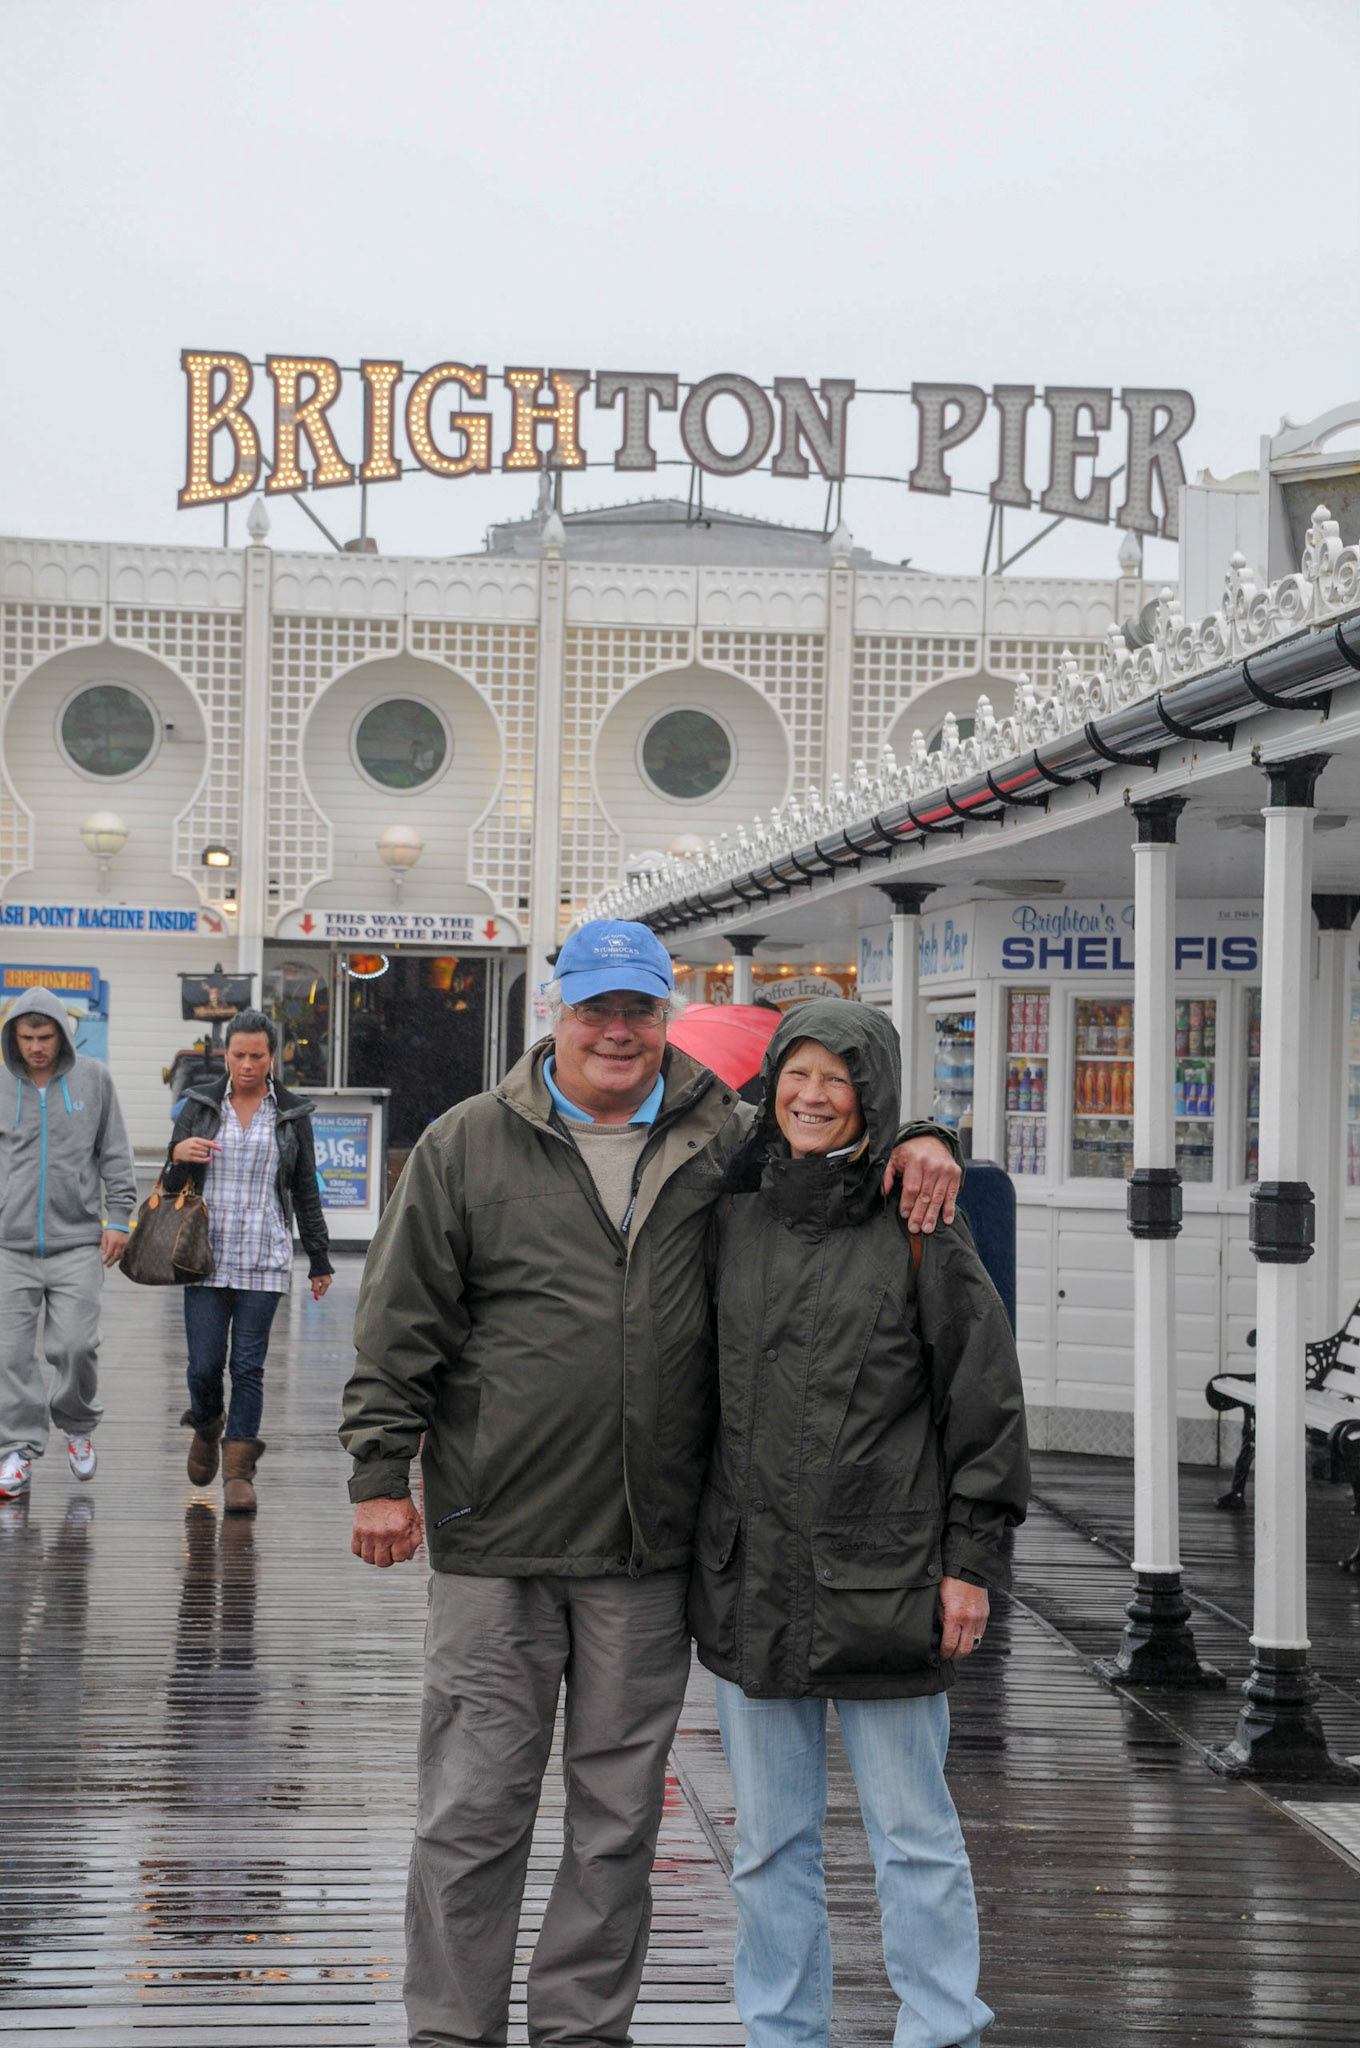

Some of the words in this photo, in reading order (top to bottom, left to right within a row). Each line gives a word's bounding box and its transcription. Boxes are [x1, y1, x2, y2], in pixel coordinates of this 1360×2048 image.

[177, 347, 856, 510] BRIGHTON
[908, 381, 1196, 541] PIER
[28, 906, 74, 927] POINT
[77, 908, 144, 930] MACHINE
[149, 911, 197, 931] INSIDE
[325, 913, 366, 925] THIS
[371, 915, 407, 926] WAY
[411, 916, 434, 927] TO
[439, 917, 474, 929] THE
[1012, 903, 1116, 939] Brighton's
[325, 926, 360, 937] END
[365, 927, 389, 938] OF
[392, 928, 427, 940] THE
[431, 929, 474, 941] PIER
[4, 969, 62, 988] BRIGHTON
[66, 971, 92, 990] PIER
[753, 983, 795, 1002] Coffee
[336, 1117, 367, 1127] COURT
[314, 1138, 355, 1168] BIG
[333, 1154, 366, 1168] FISH
